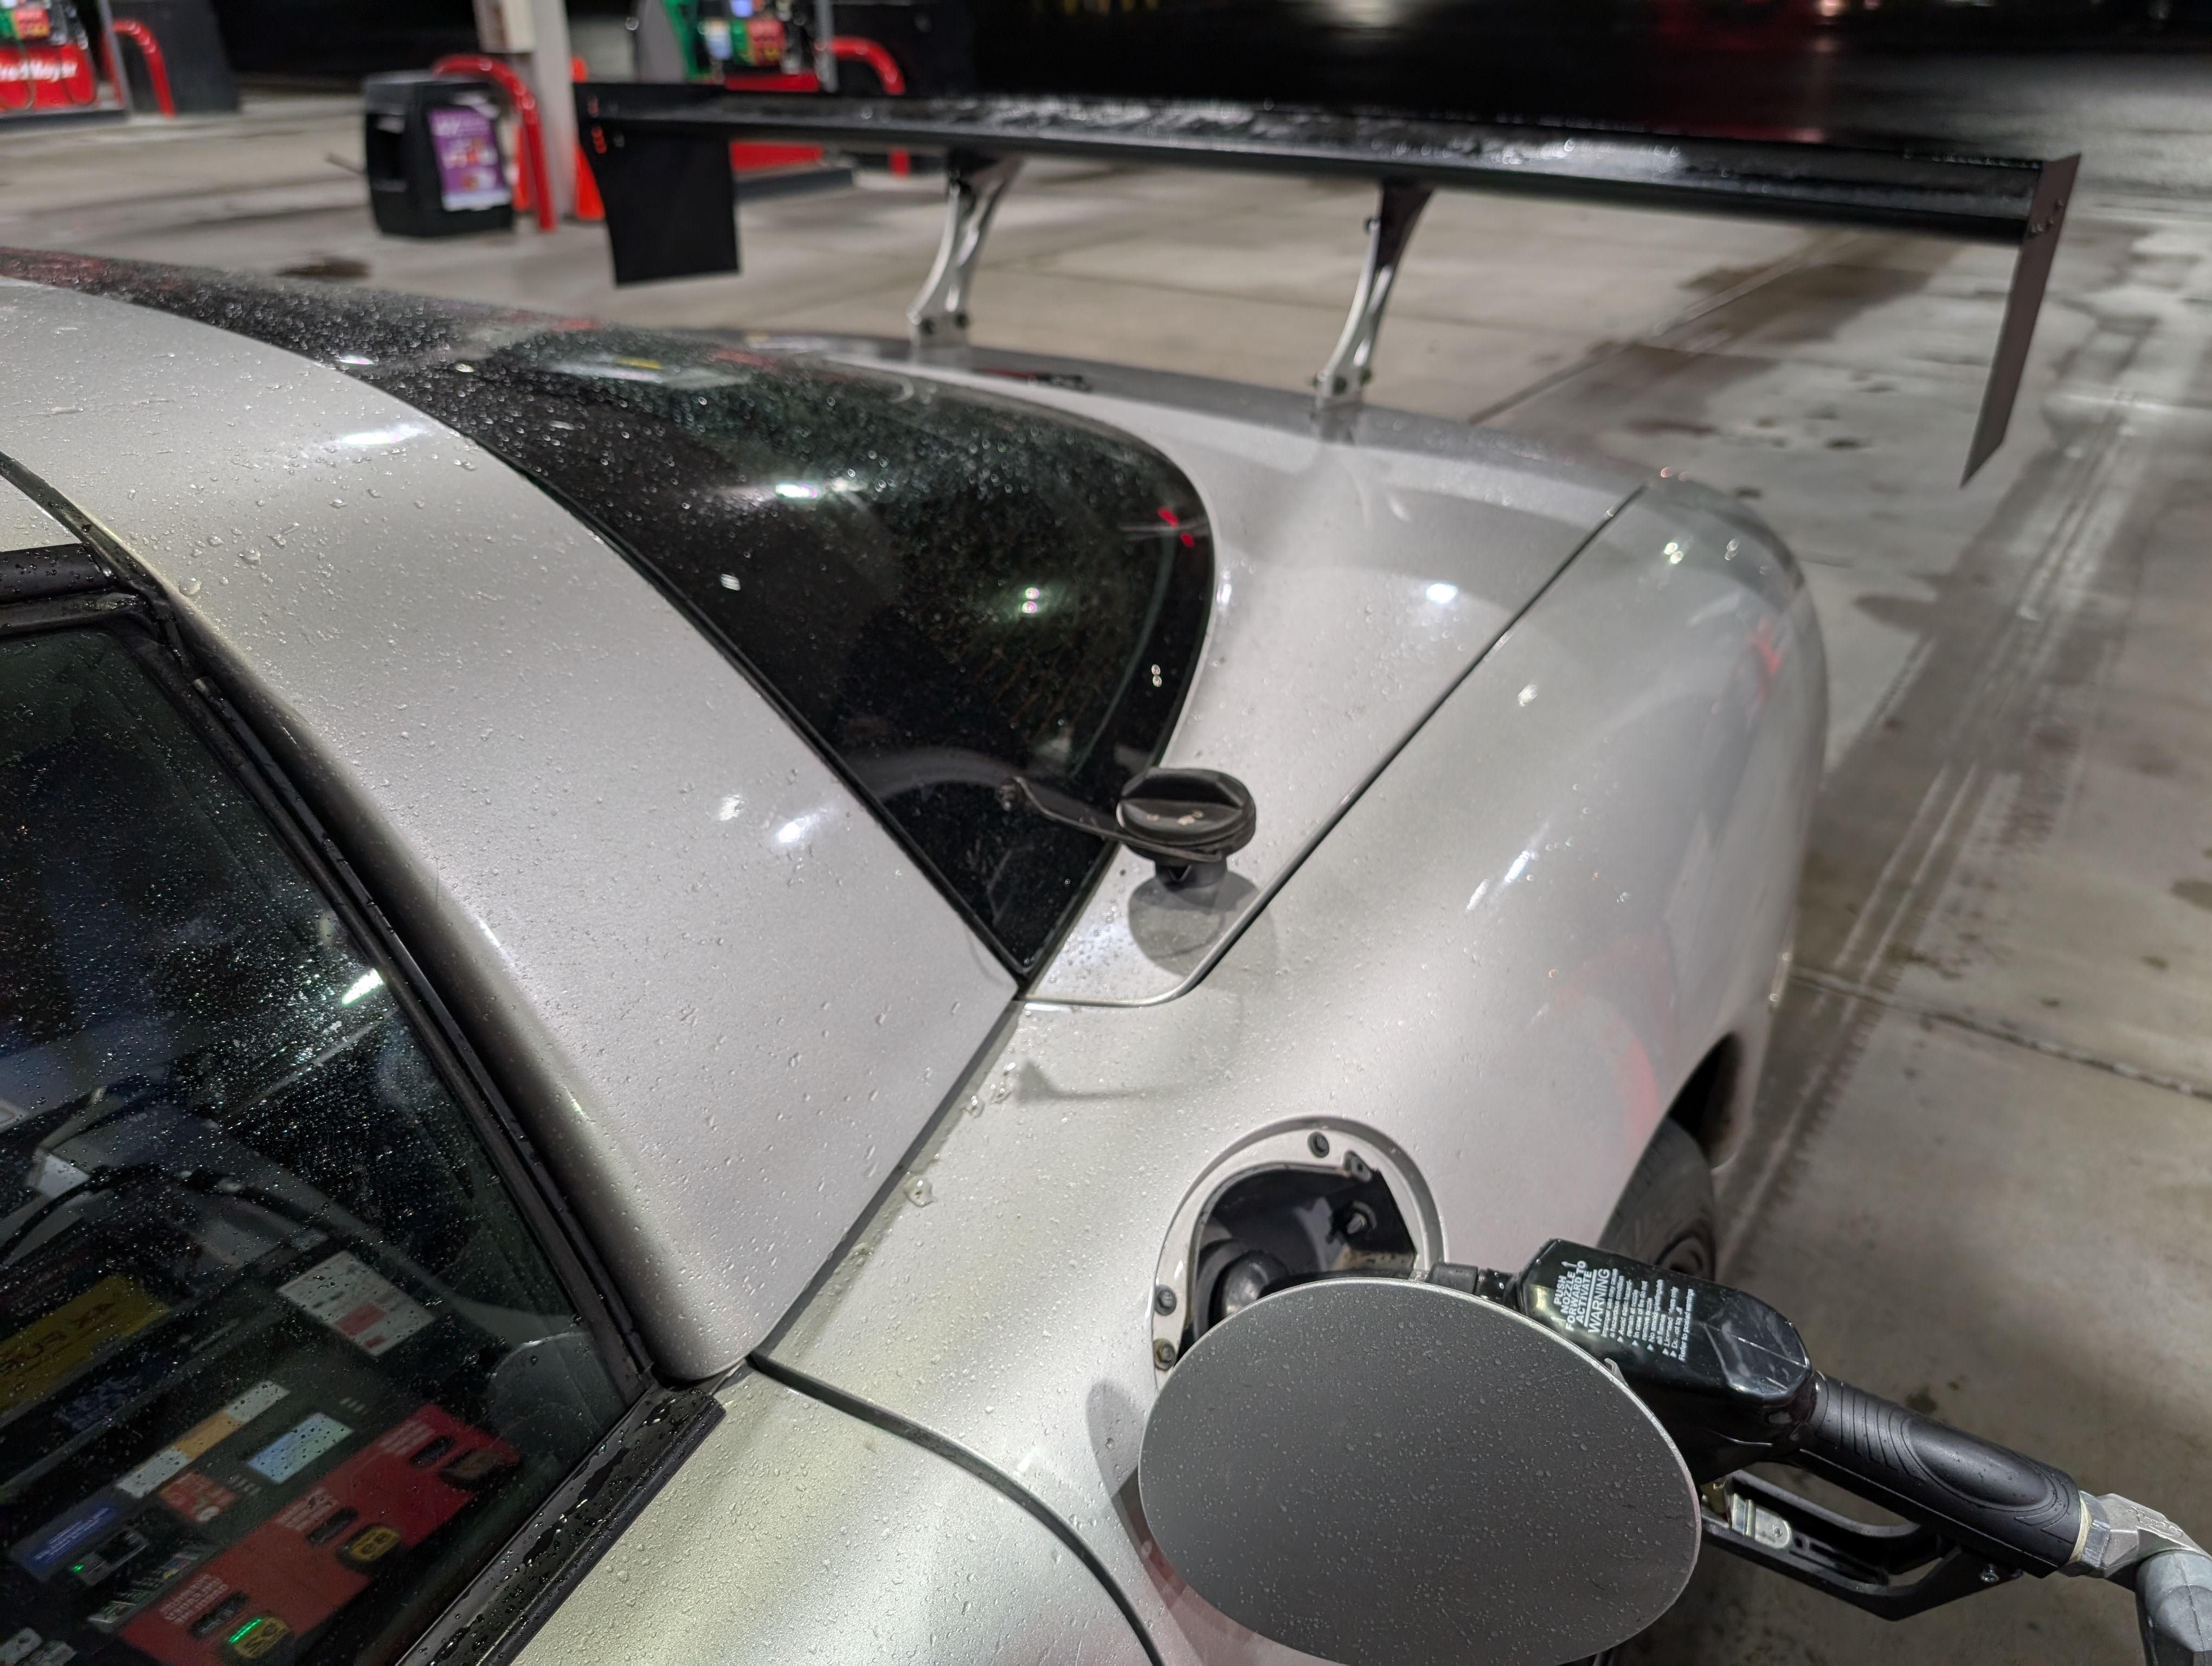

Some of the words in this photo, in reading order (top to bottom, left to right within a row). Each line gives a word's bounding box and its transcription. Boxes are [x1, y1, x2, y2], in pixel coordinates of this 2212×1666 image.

[1554, 1275, 1567, 1305] PUSH
[1560, 1271, 1576, 1314] NOZZLE
[1566, 1277, 1582, 1331] FORWARD
[1576, 1260, 1587, 1275] TO
[1576, 1271, 1592, 1325] ACTIVATE
[1587, 1268, 1610, 1333] WARNING
[1639, 1291, 1646, 1299] do
[1670, 1286, 1680, 1299] only
[1610, 1300, 1620, 1332] hazardous
[1616, 1276, 1624, 1300] condition
[1622, 1300, 1630, 1317] static
[1626, 1315, 1635, 1337] remain
[1631, 1289, 1639, 1308] nozzle
[1601, 1310, 1611, 1338] Improper
[1642, 1316, 1650, 1342] remove
[1648, 1332, 1656, 1343] No
[1657, 1313, 1666, 1335] flames
[1671, 1338, 1679, 1349] Do
[1678, 1341, 1687, 1362] Refer
